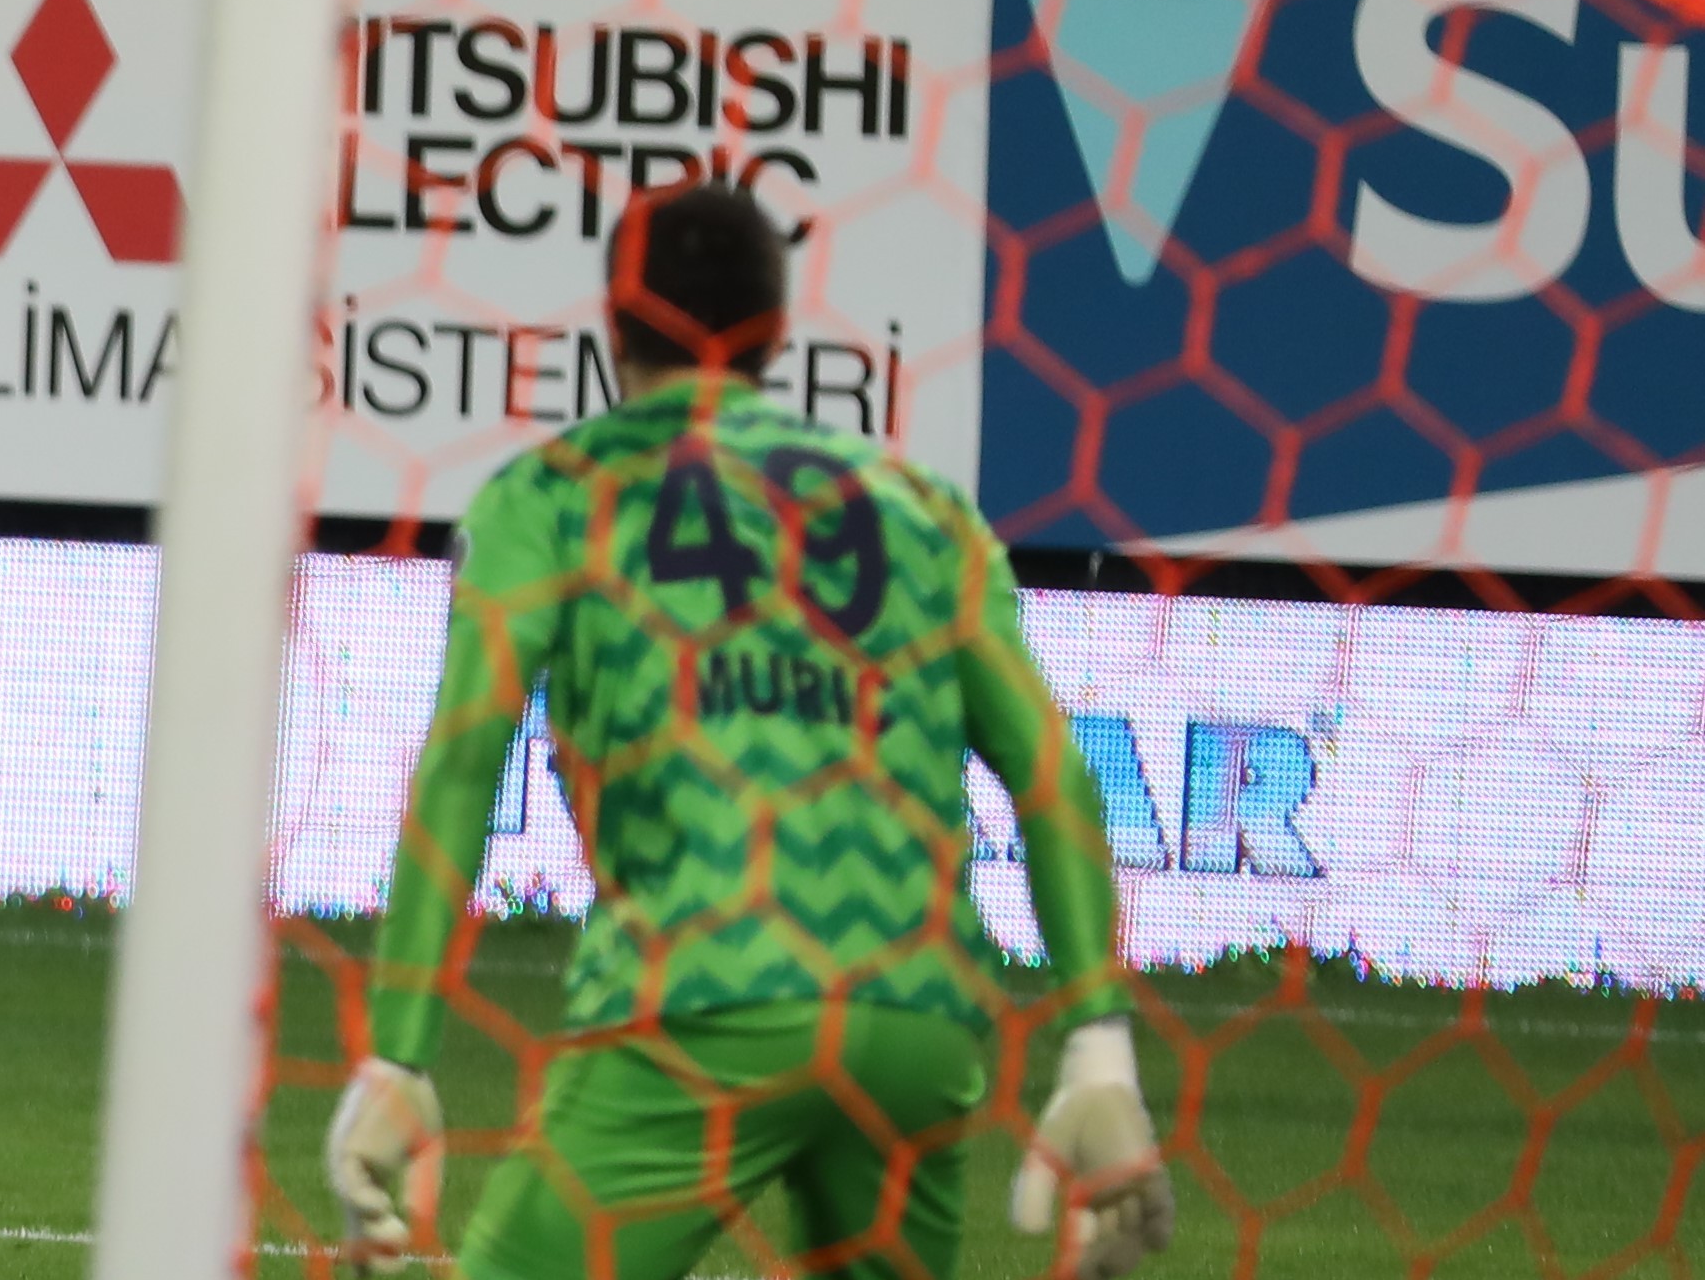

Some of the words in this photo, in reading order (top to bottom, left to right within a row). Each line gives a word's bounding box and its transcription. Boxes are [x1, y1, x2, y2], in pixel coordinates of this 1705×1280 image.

[341, 16, 911, 138] ITSUBISHI
[333, 128, 819, 247] LECTC
[315, 295, 901, 439] İSTERİ
[647, 429, 889, 638] 49
